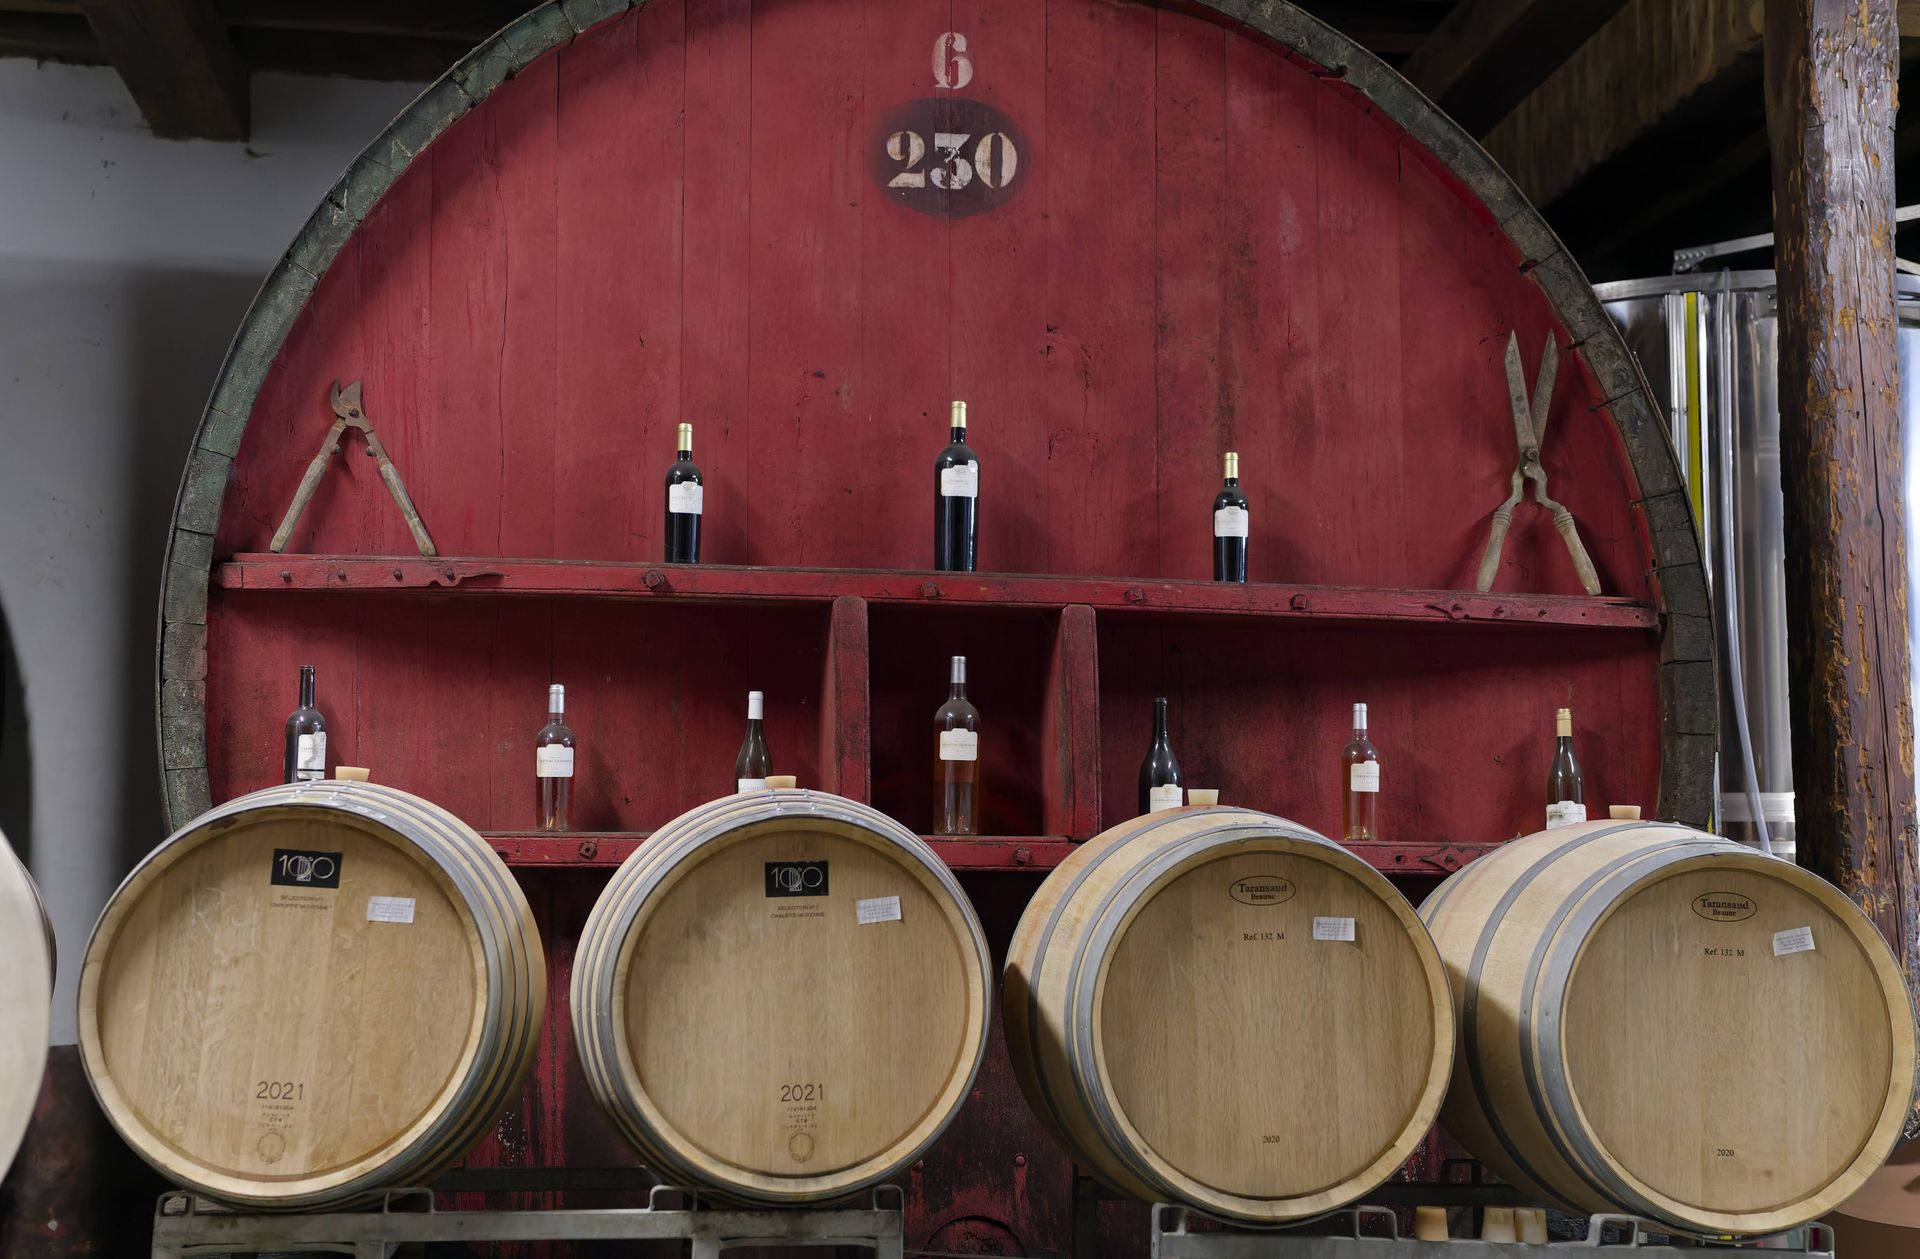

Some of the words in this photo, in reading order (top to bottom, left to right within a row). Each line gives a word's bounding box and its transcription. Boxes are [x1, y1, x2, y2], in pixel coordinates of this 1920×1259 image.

[932, 31, 974, 90] 6
[886, 130, 1018, 190] 230
[1238, 883, 1287, 893] Taransaud
[1700, 898, 1750, 909] Taransaud
[1712, 908, 1737, 917] Beaune
[1243, 933, 1258, 941] Ref.
[1260, 932, 1273, 941] 132
[1276, 932, 1285, 940] M
[1704, 947, 1718, 956] Ref.
[1720, 948, 1733, 957] 132
[1736, 949, 1745, 957] M
[256, 1081, 304, 1100] 2021
[781, 1083, 823, 1102] 2021
[1262, 1135, 1280, 1144] 2020
[1716, 1148, 1735, 1157] 2020
